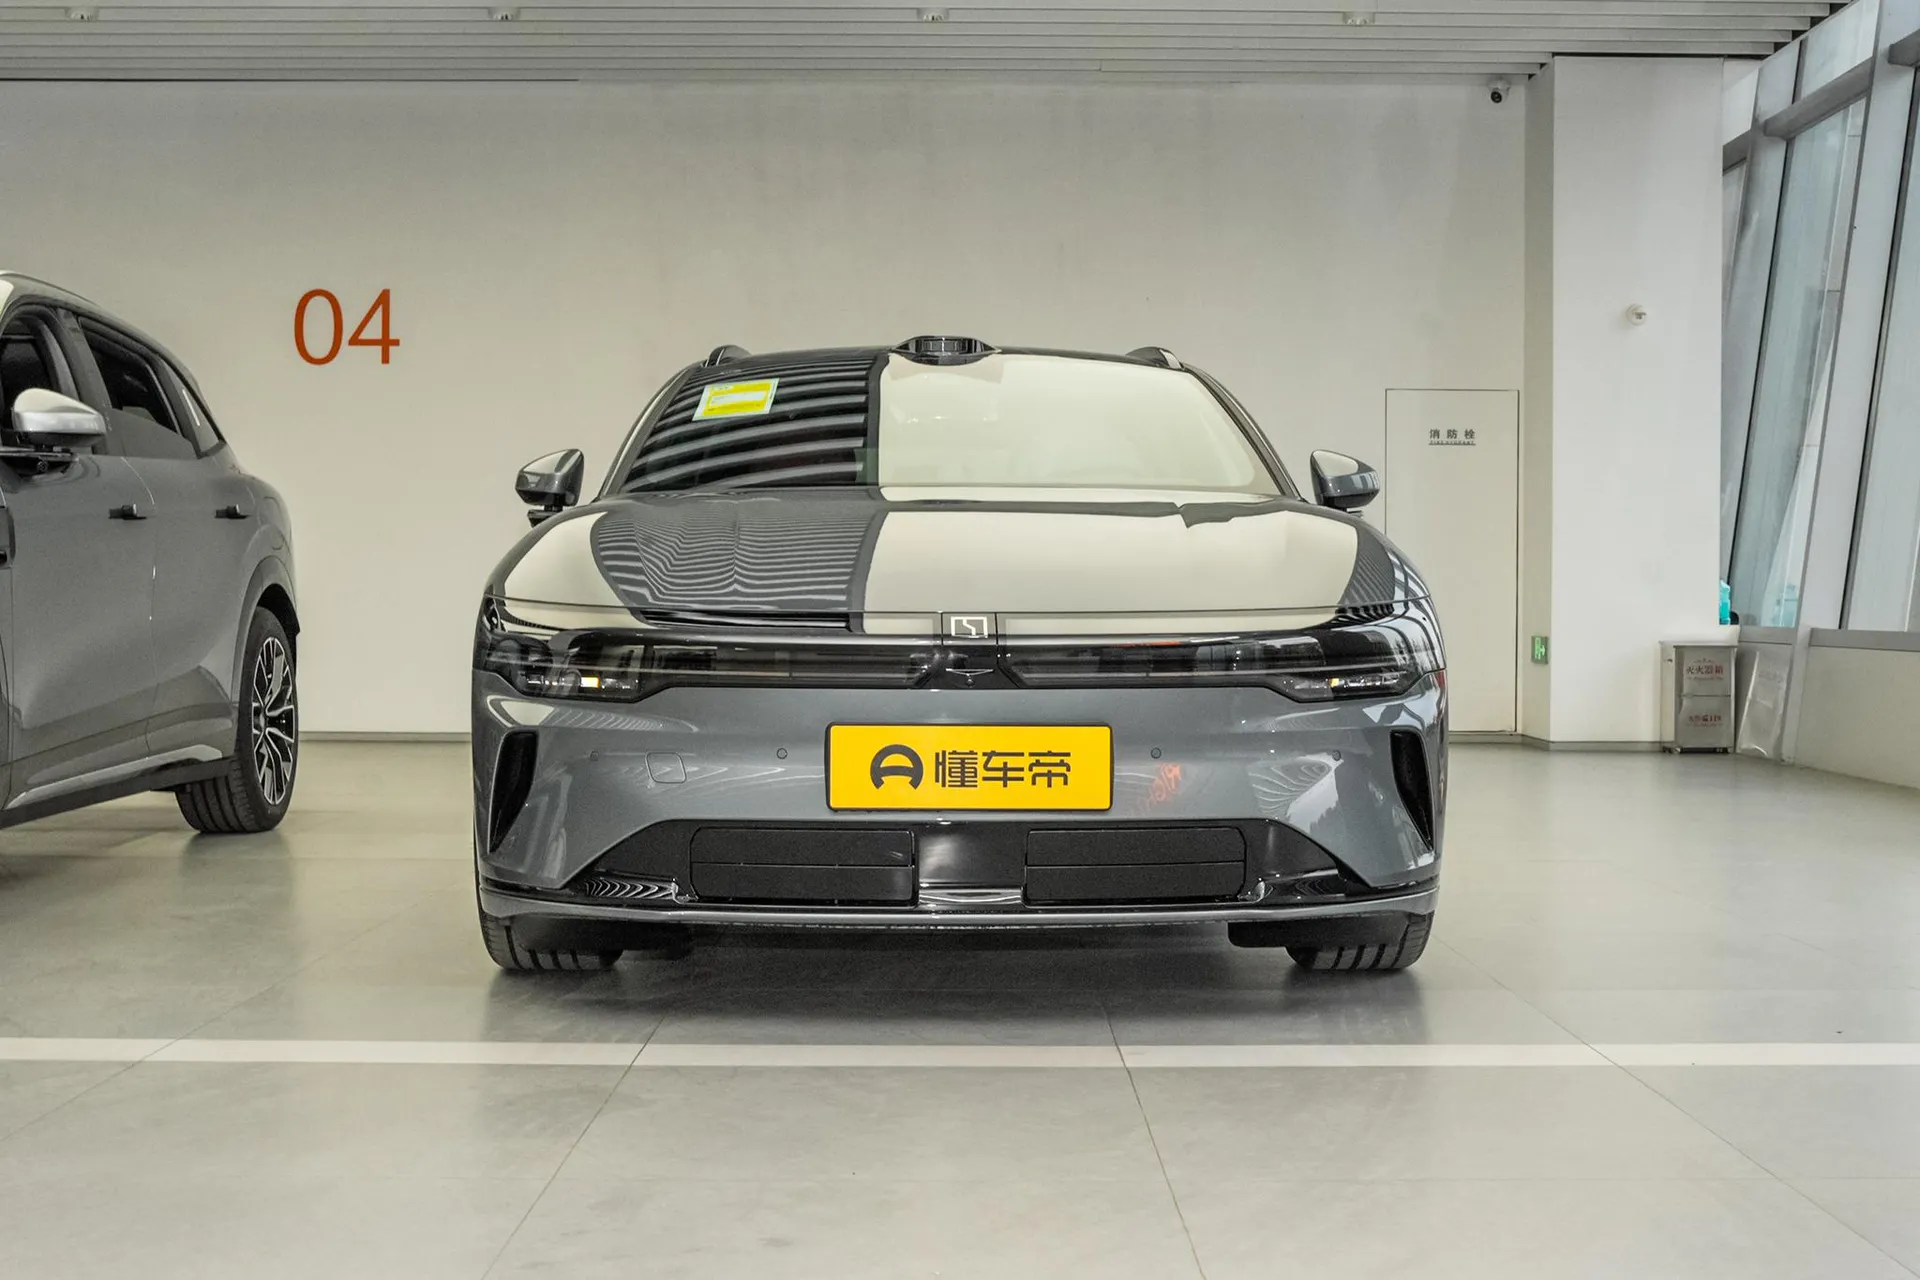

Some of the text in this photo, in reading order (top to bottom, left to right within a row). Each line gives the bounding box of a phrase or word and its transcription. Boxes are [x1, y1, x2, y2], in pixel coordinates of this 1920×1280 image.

[294, 288, 400, 366] 04
[1429, 428, 1476, 440] 消防栓
[934, 749, 1072, 788] 懂车帝
